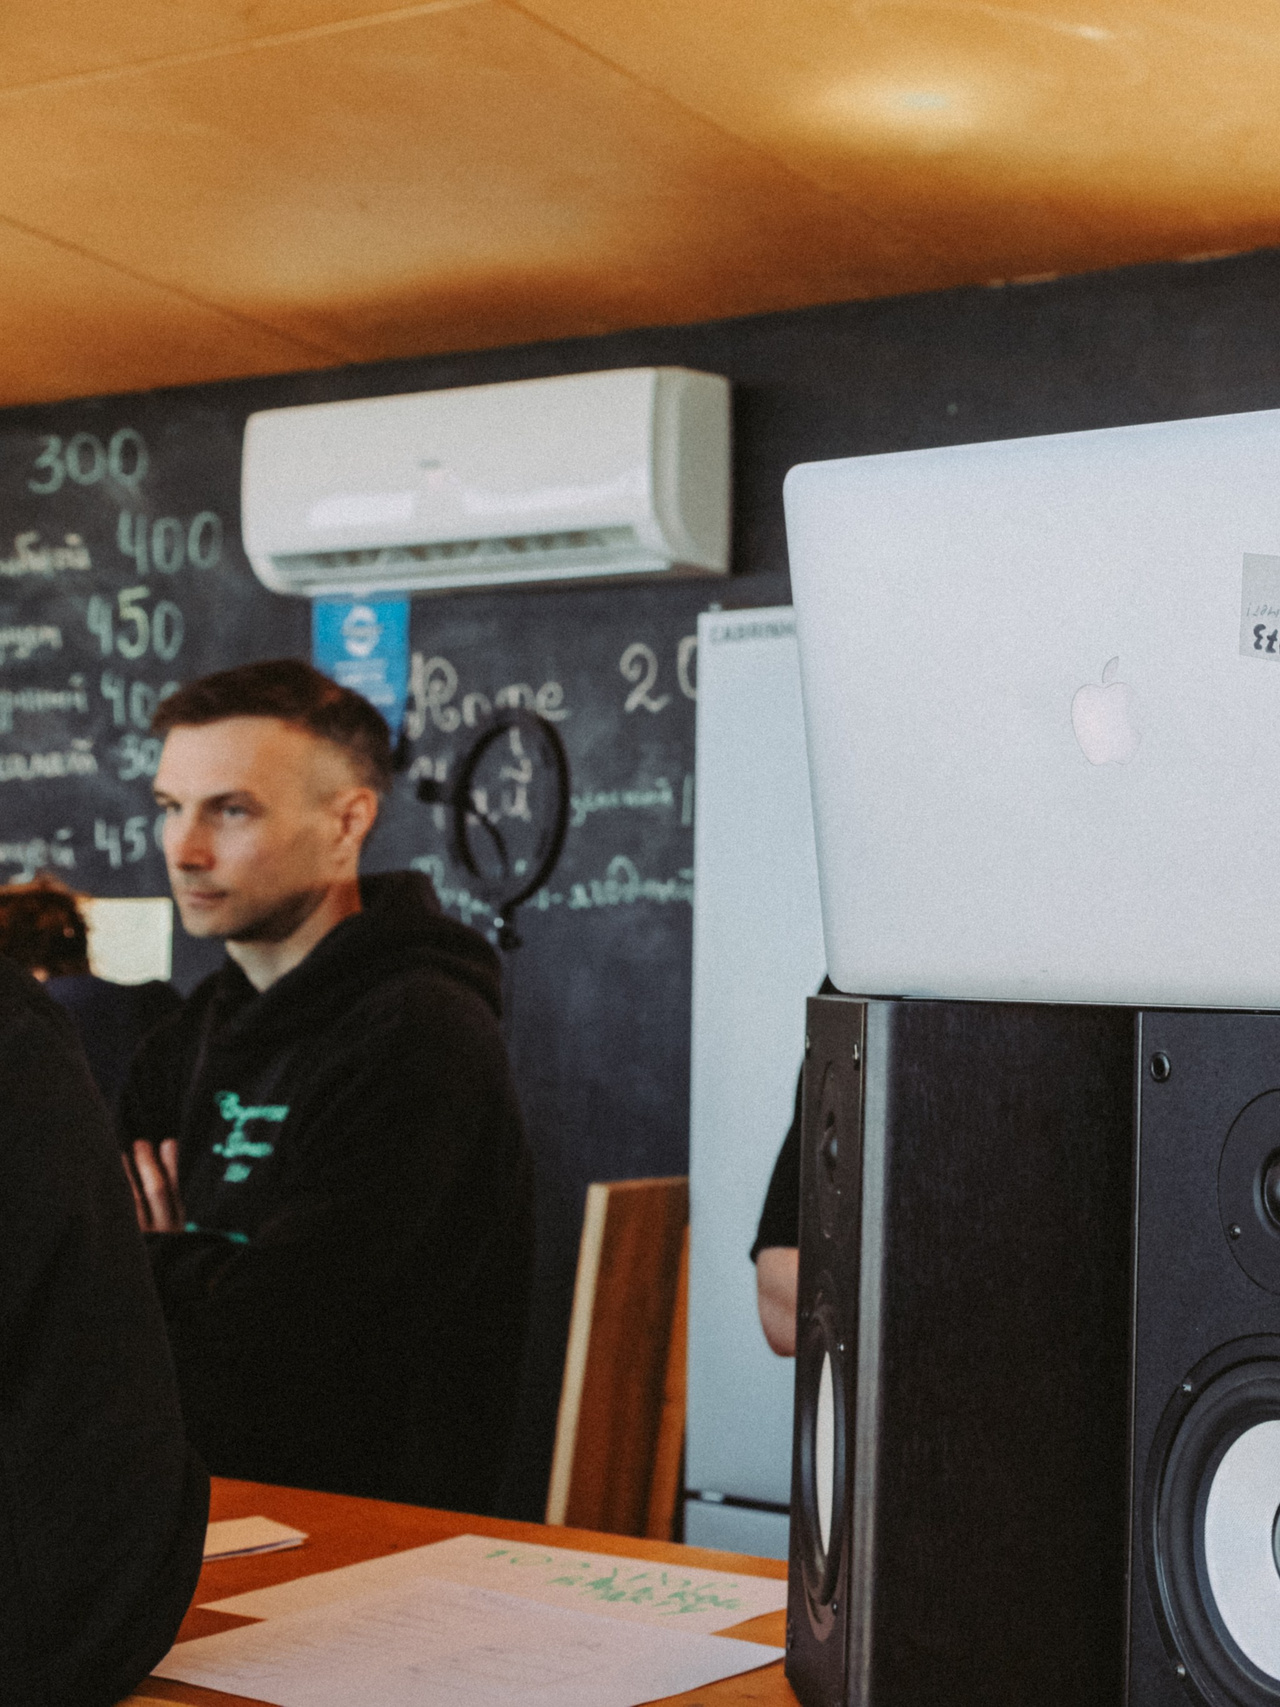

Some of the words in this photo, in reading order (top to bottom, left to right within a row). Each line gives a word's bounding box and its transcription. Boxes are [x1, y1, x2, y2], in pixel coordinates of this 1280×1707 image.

[27, 427, 149, 495] 300
[116, 509, 223, 576] 400
[87, 585, 185, 660] 450
[93, 816, 167, 870] 45
